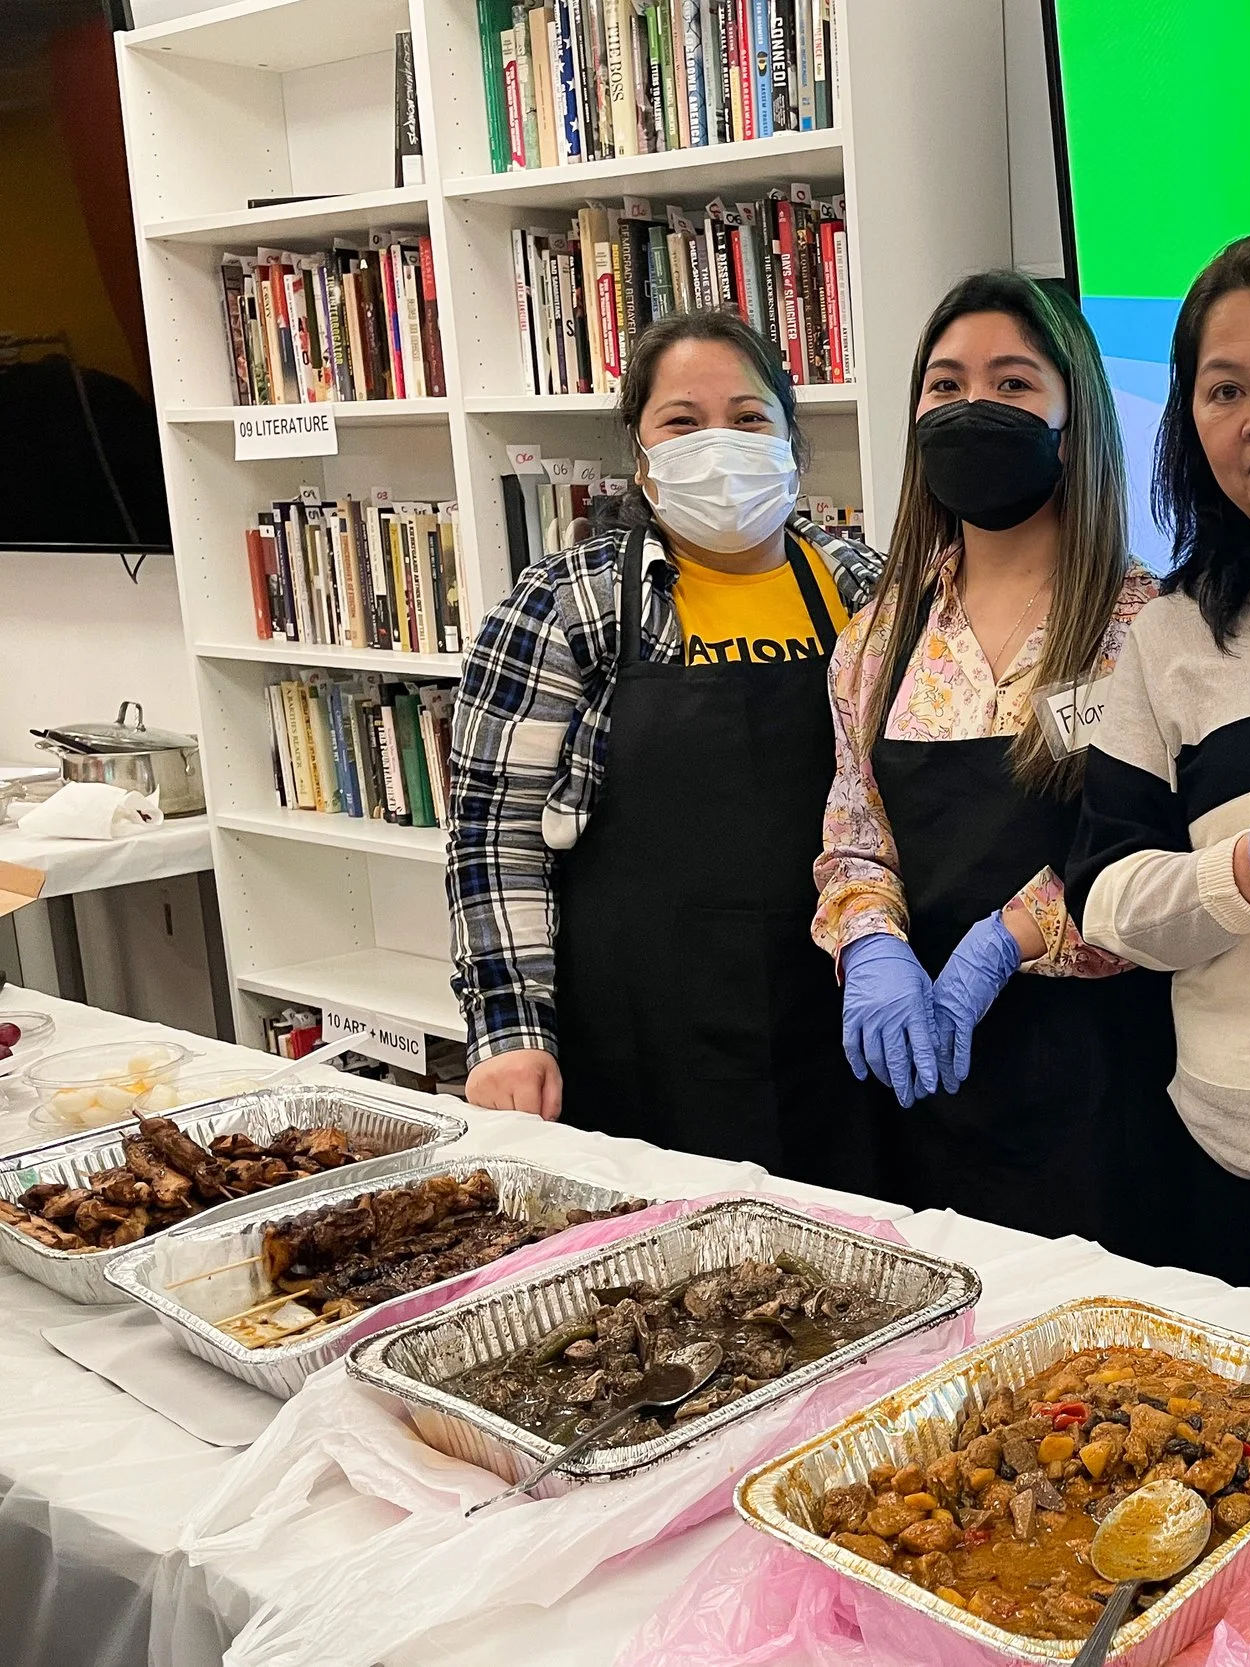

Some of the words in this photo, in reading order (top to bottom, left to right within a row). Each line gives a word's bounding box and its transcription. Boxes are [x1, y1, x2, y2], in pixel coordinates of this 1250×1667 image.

[607, 22, 622, 59] THE
[685, 32, 697, 92] LOCKDOWN
[610, 60, 625, 103] BOSS
[650, 57, 661, 86] LETTERS
[653, 96, 663, 131] PALESTINE
[689, 96, 701, 144] AMERICA
[742, 82, 752, 137] GREENWALD
[620, 223, 633, 284] DEMOCRACY
[781, 253, 792, 276] DAYS
[720, 252, 731, 300] DISSENT
[614, 282, 624, 327] BABYLON
[625, 288, 637, 334] BETRAYED
[765, 274, 776, 322] MODERNIST
[784, 289, 798, 340] SLAUGHTER
[329, 294, 343, 365] INTERROGATOR
[770, 324, 778, 343] CITY
[240, 422, 252, 437] 09
[256, 415, 329, 436] LITERATURE
[553, 464, 568, 475] 06
[581, 468, 595, 479] 06
[414, 574, 423, 612] ANTHOLOGY
[689, 634, 818, 664] ATION
[292, 735, 303, 768] READER
[327, 1012, 340, 1028] 10
[344, 1018, 367, 1034] ART
[379, 1029, 419, 1055] MUSIC
